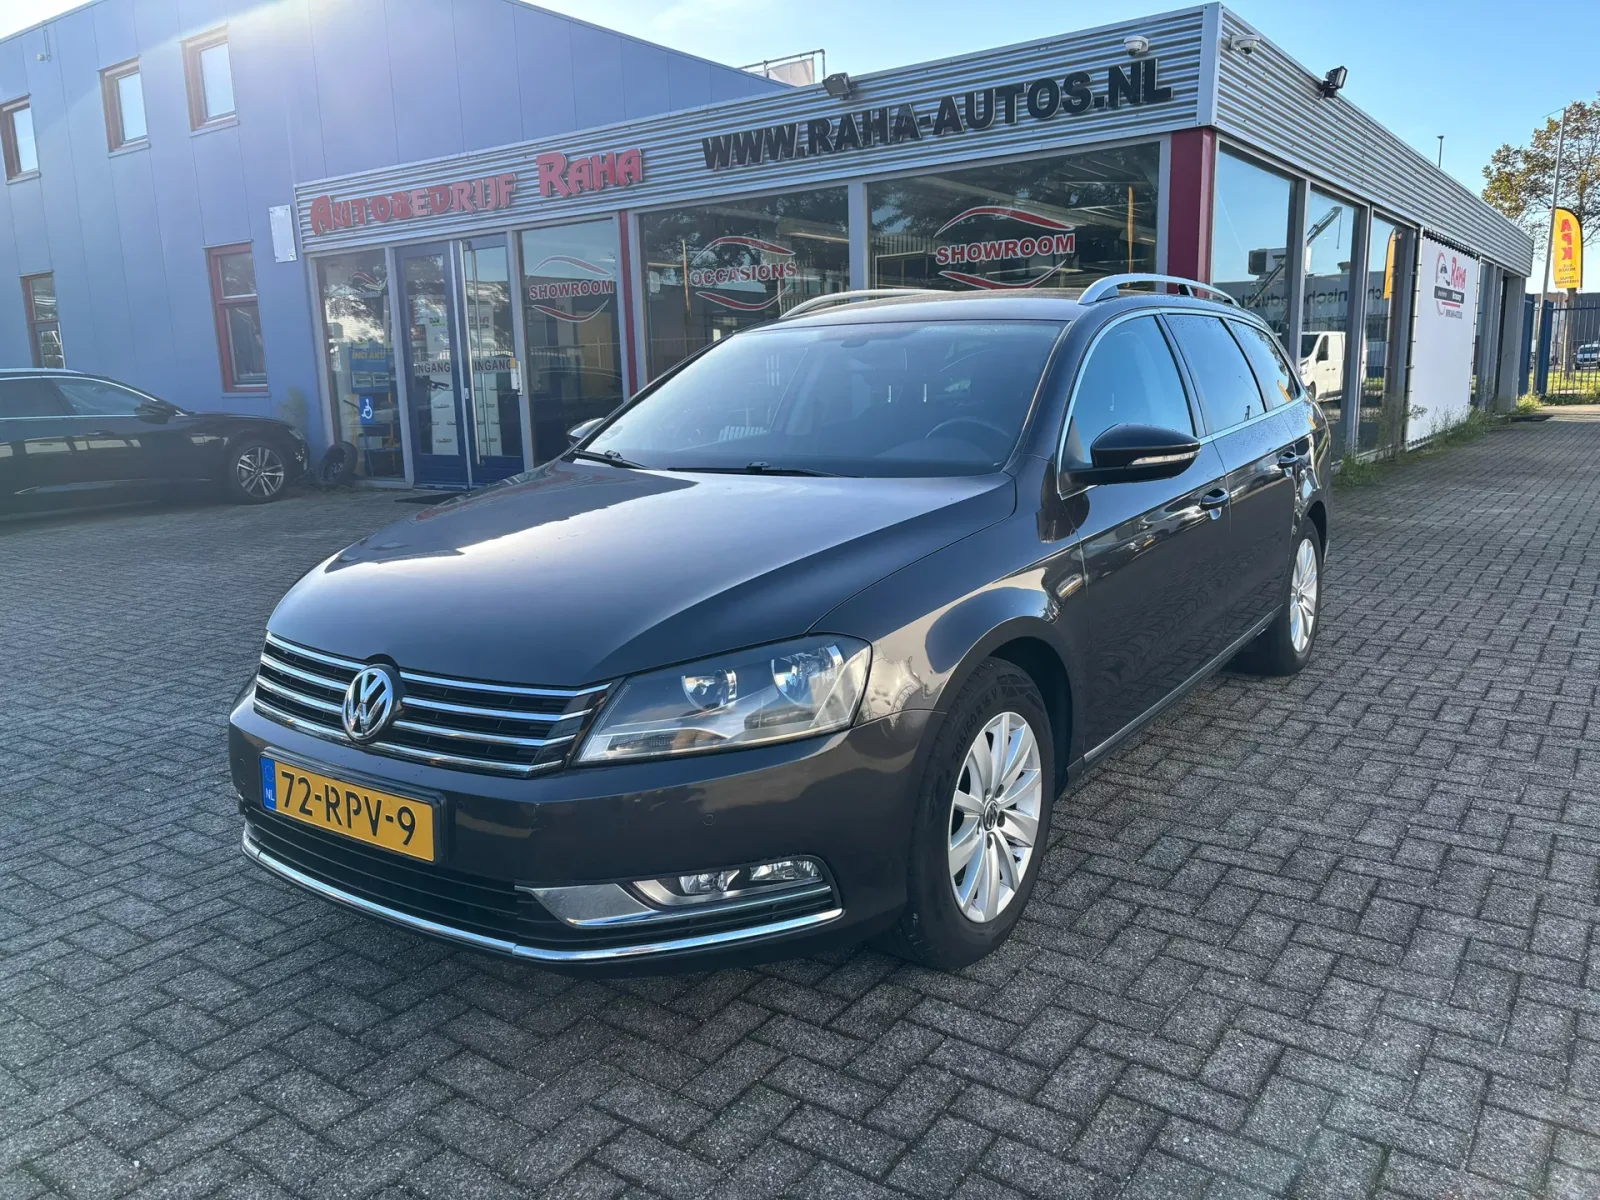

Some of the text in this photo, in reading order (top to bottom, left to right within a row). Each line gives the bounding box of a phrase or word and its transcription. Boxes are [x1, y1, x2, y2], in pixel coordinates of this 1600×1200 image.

[702, 58, 1173, 170] WWW.RAHA-AUTOS.NL
[535, 148, 644, 199] RAHA
[935, 233, 1076, 265] SHOWROOM
[690, 262, 798, 287] OCCASIONS
[528, 280, 614, 301] SHOWROOM
[415, 362, 451, 374] INGANG
[265, 787, 275, 802] NL
[281, 770, 416, 846] 72-RPV-9
